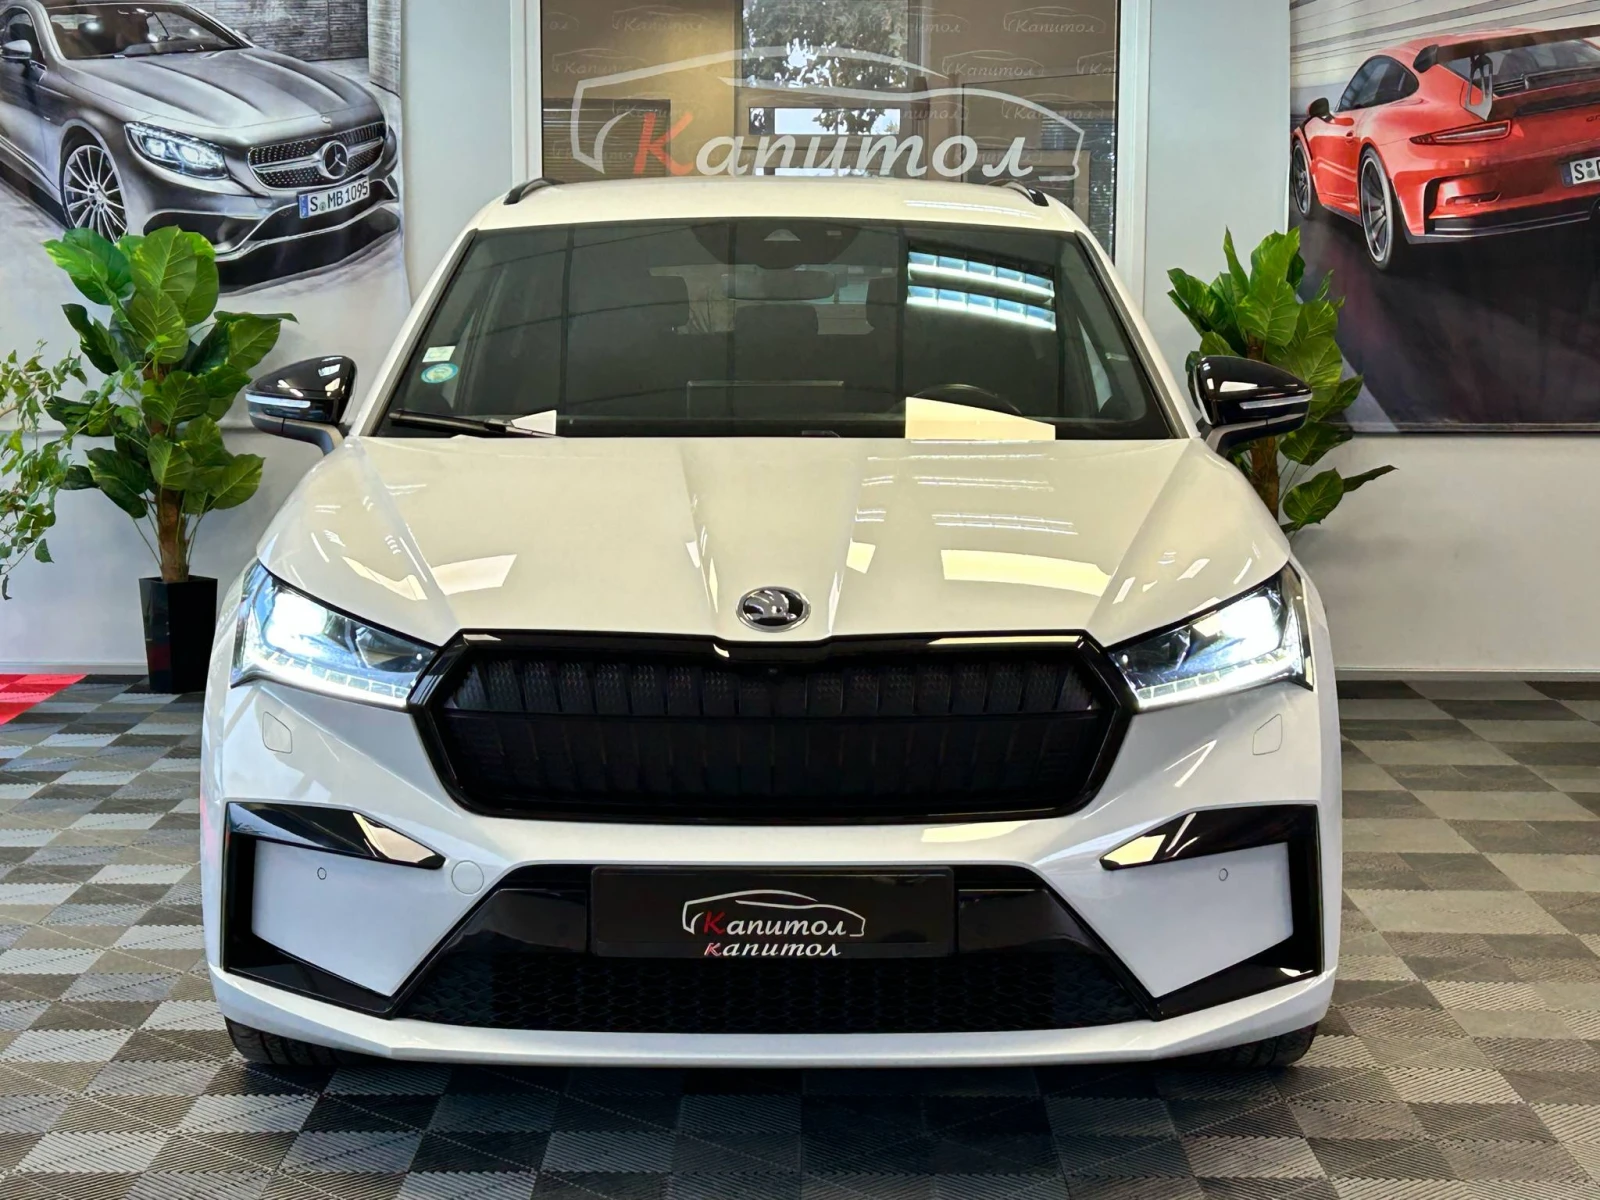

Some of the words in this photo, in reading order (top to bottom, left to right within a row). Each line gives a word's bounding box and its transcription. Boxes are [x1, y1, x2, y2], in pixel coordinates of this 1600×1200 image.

[1016, 19, 1096, 33] Капитол
[633, 111, 1033, 177] Капитол
[703, 911, 847, 936] Капитол
